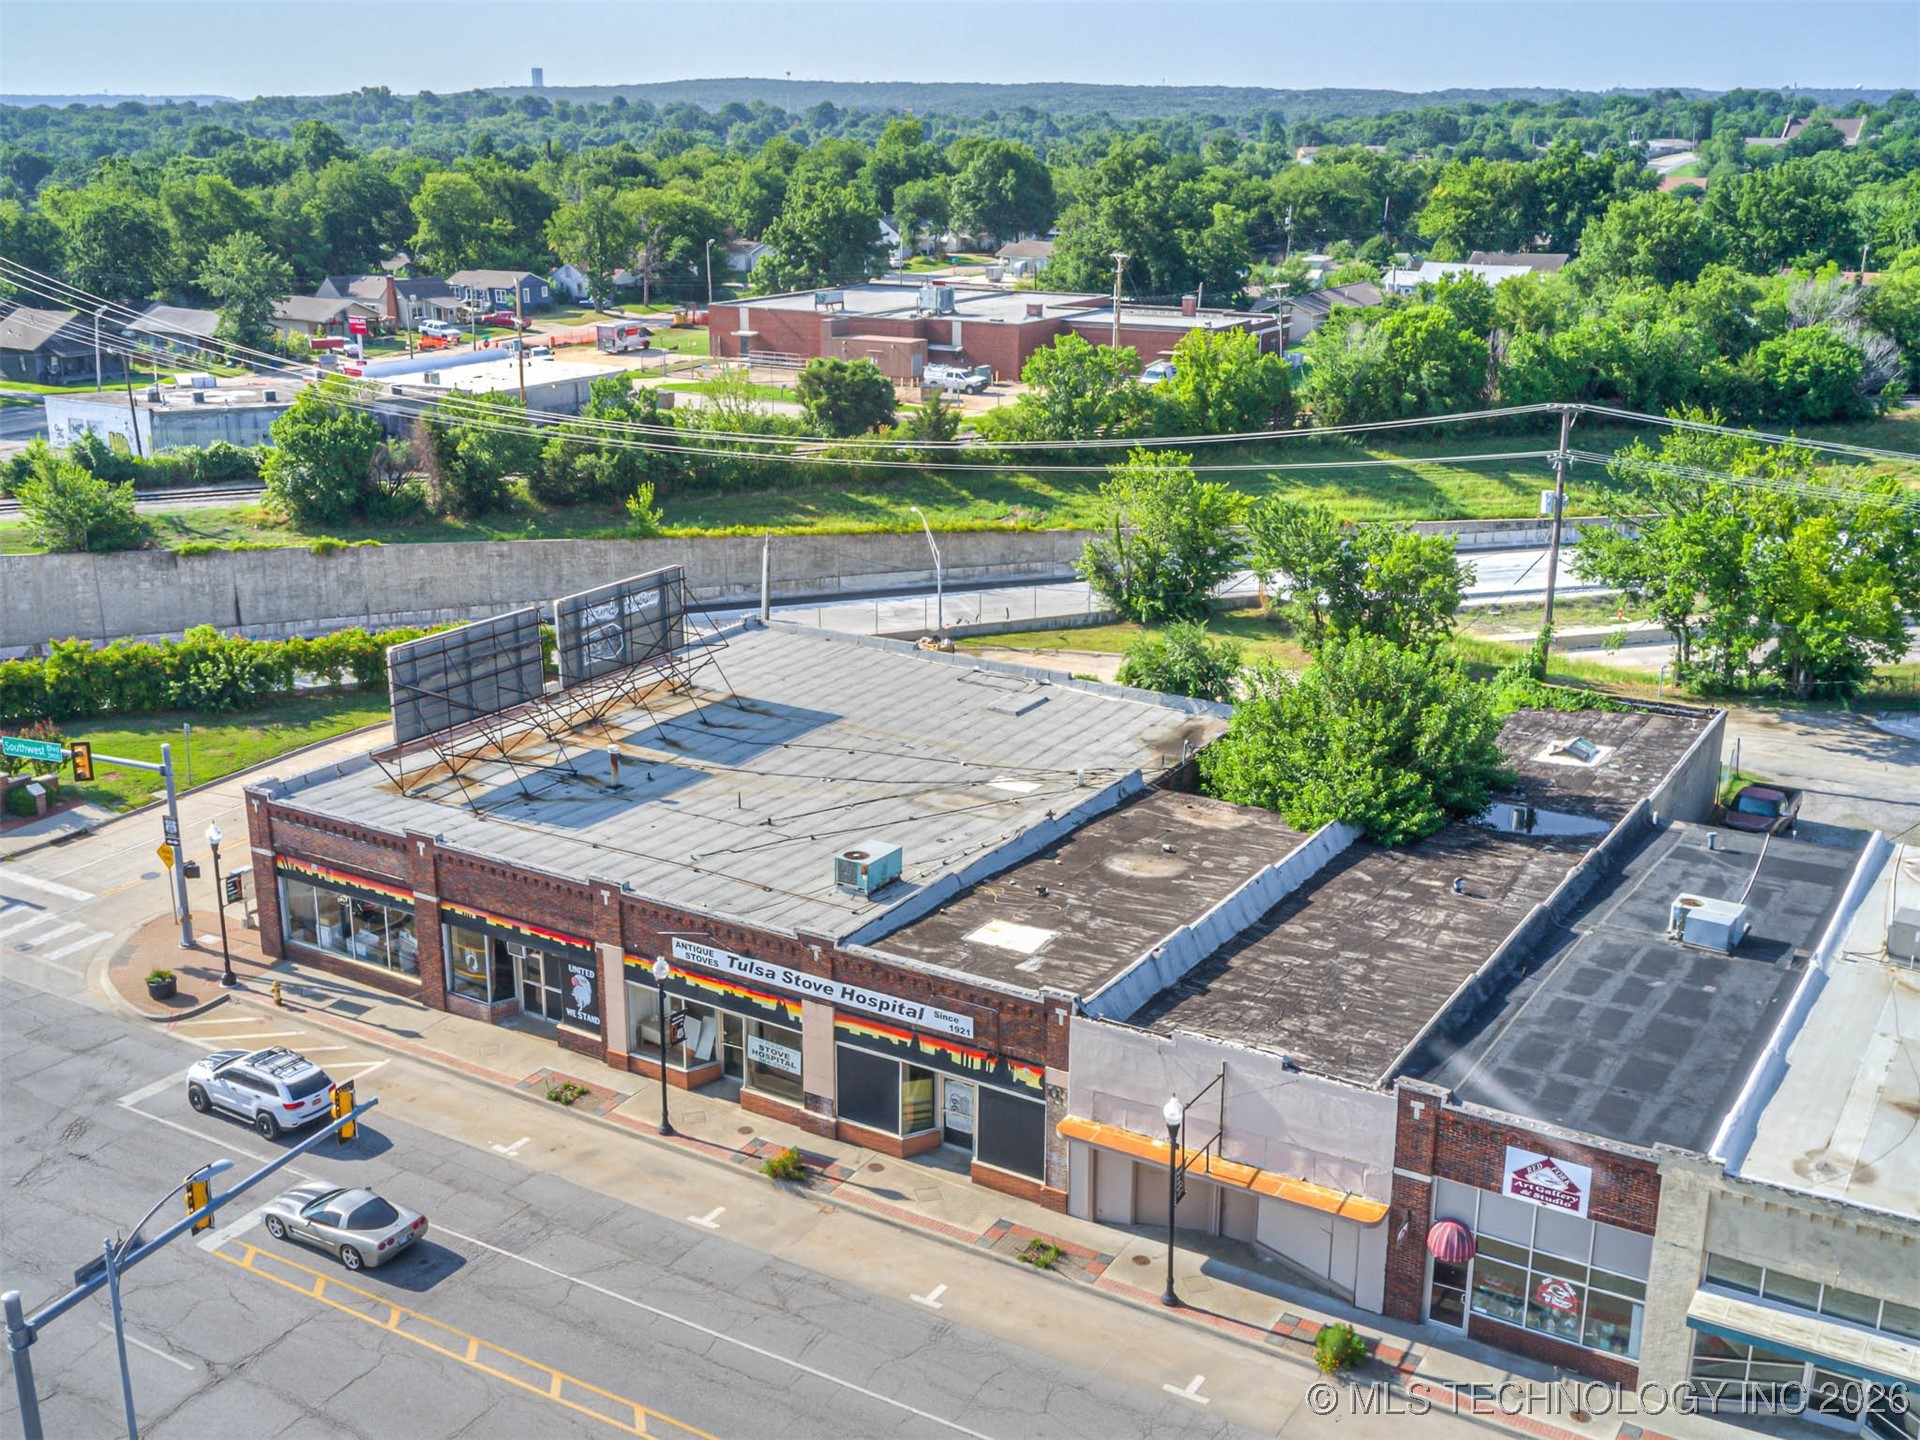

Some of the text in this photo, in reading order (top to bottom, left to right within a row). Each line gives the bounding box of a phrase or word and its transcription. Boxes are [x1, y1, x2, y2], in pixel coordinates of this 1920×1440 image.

[4, 741, 45, 756] Southwest
[675, 940, 715, 958] ANTIQUE
[685, 951, 719, 968] STOVES
[568, 964, 595, 979] UNITED
[726, 955, 925, 1020] Tulsa Stove Hospital
[566, 1007, 601, 1025] WE STAND
[933, 1011, 960, 1024] Since
[949, 1024, 971, 1037] 1921
[751, 1048, 797, 1069] HOSPITAL
[758, 1044, 791, 1060] STOVE
[1527, 1162, 1570, 1187] RED FORK
[1514, 1180, 1579, 1204] Art Gallery
[1520, 1189, 1572, 1208] & Studio
